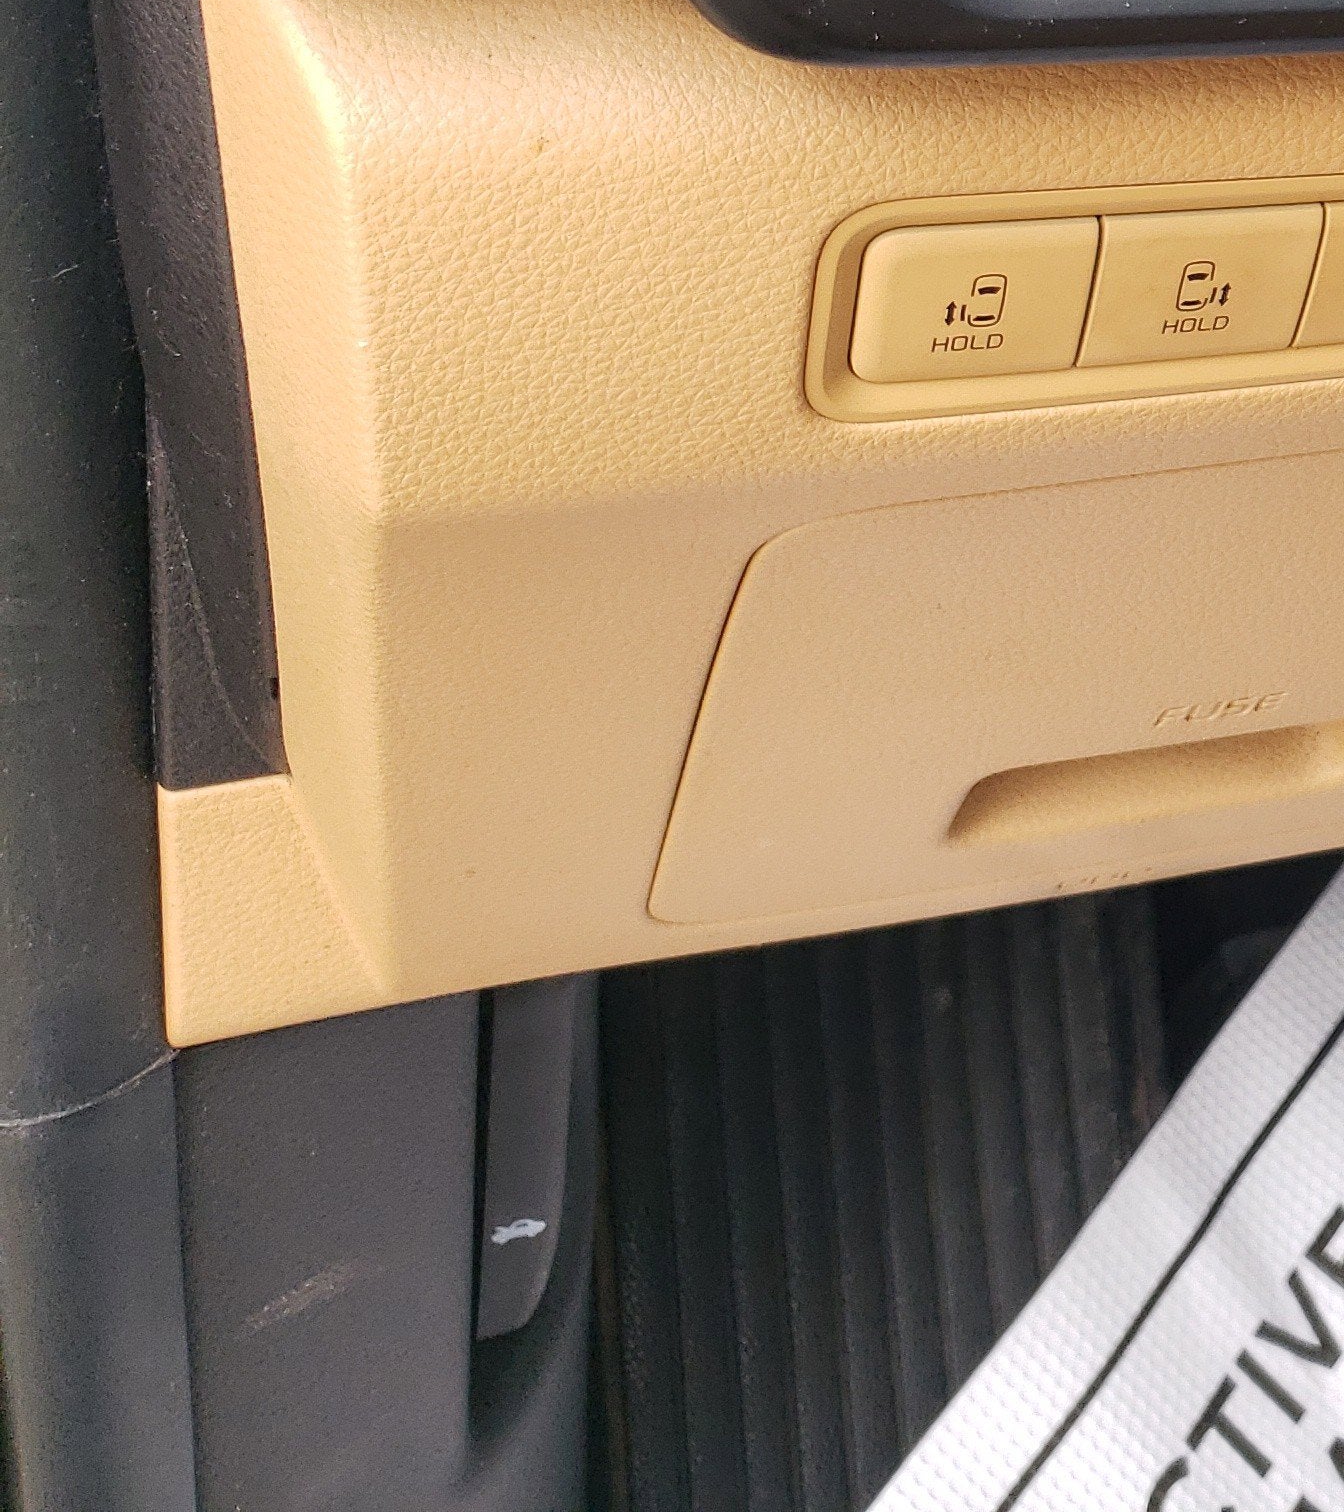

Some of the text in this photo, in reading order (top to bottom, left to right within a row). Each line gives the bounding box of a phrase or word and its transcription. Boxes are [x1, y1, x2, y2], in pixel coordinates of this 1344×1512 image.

[1161, 315, 1230, 334] HOLD
[930, 333, 1004, 353] HOLD
[1154, 691, 1289, 726] FUSE
